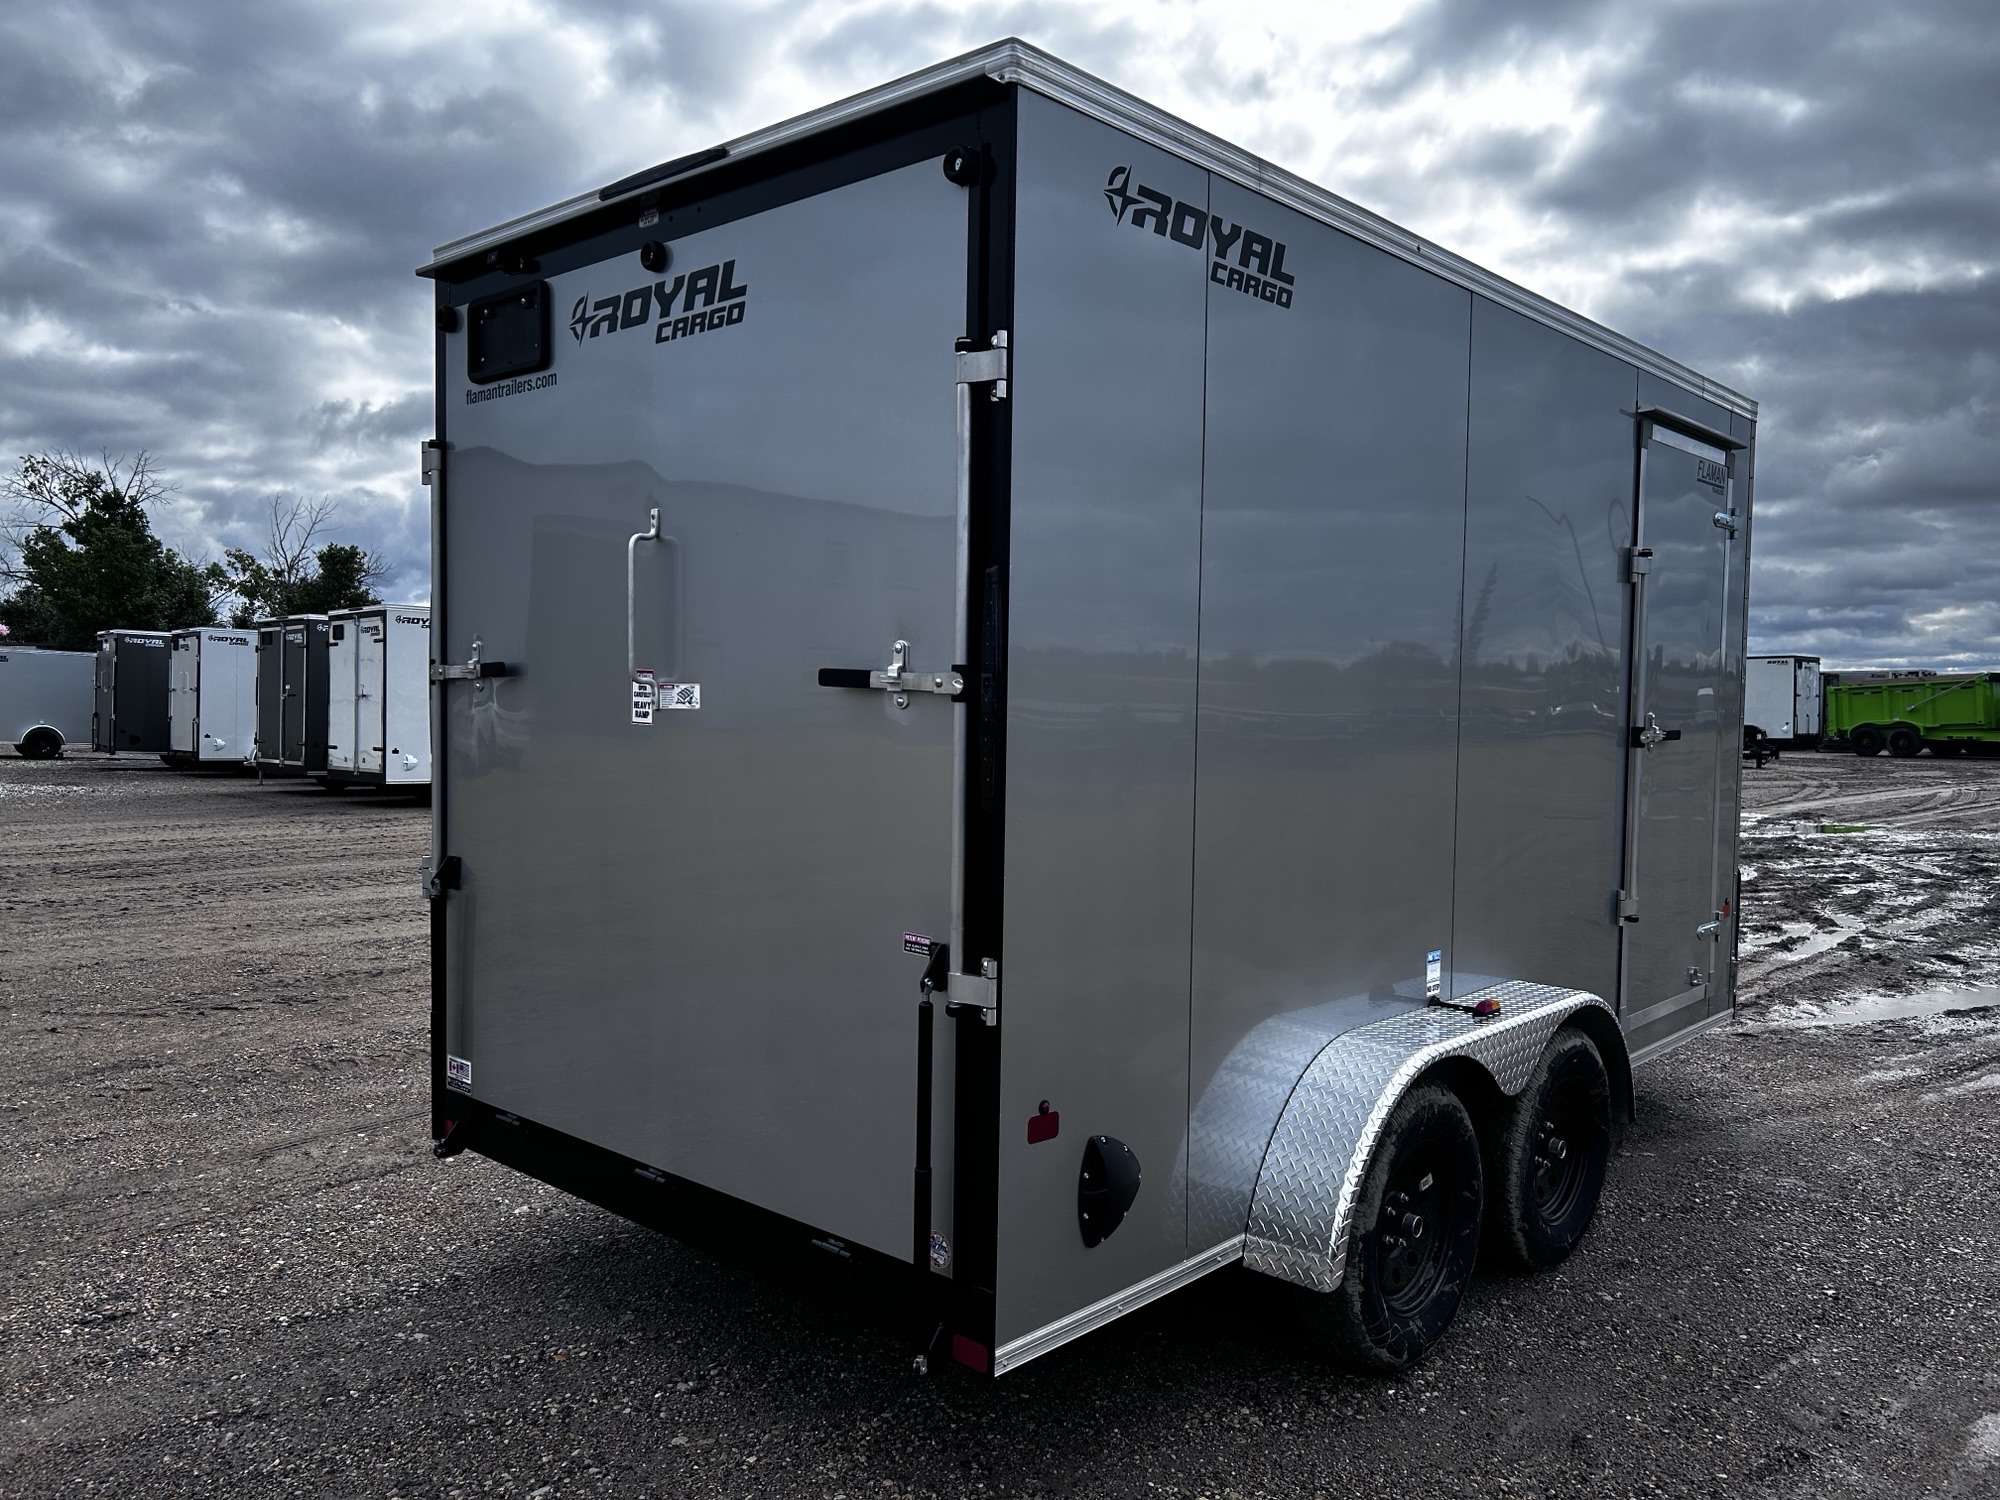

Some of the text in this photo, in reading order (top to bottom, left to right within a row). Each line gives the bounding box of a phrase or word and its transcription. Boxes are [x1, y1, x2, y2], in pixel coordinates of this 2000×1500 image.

[1131, 183, 1296, 287] ROYAL
[588, 258, 748, 339] ROYAL
[1210, 261, 1294, 310] CARGO
[655, 301, 747, 345] CARGO
[466, 372, 558, 406] flamantrailers.com
[1697, 459, 1727, 485] FLAMAN
[129, 637, 165, 646] ROYAL
[213, 635, 248, 644] ROYAL
[633, 701, 651, 709] HEAVY
[635, 710, 650, 718] RAMP
